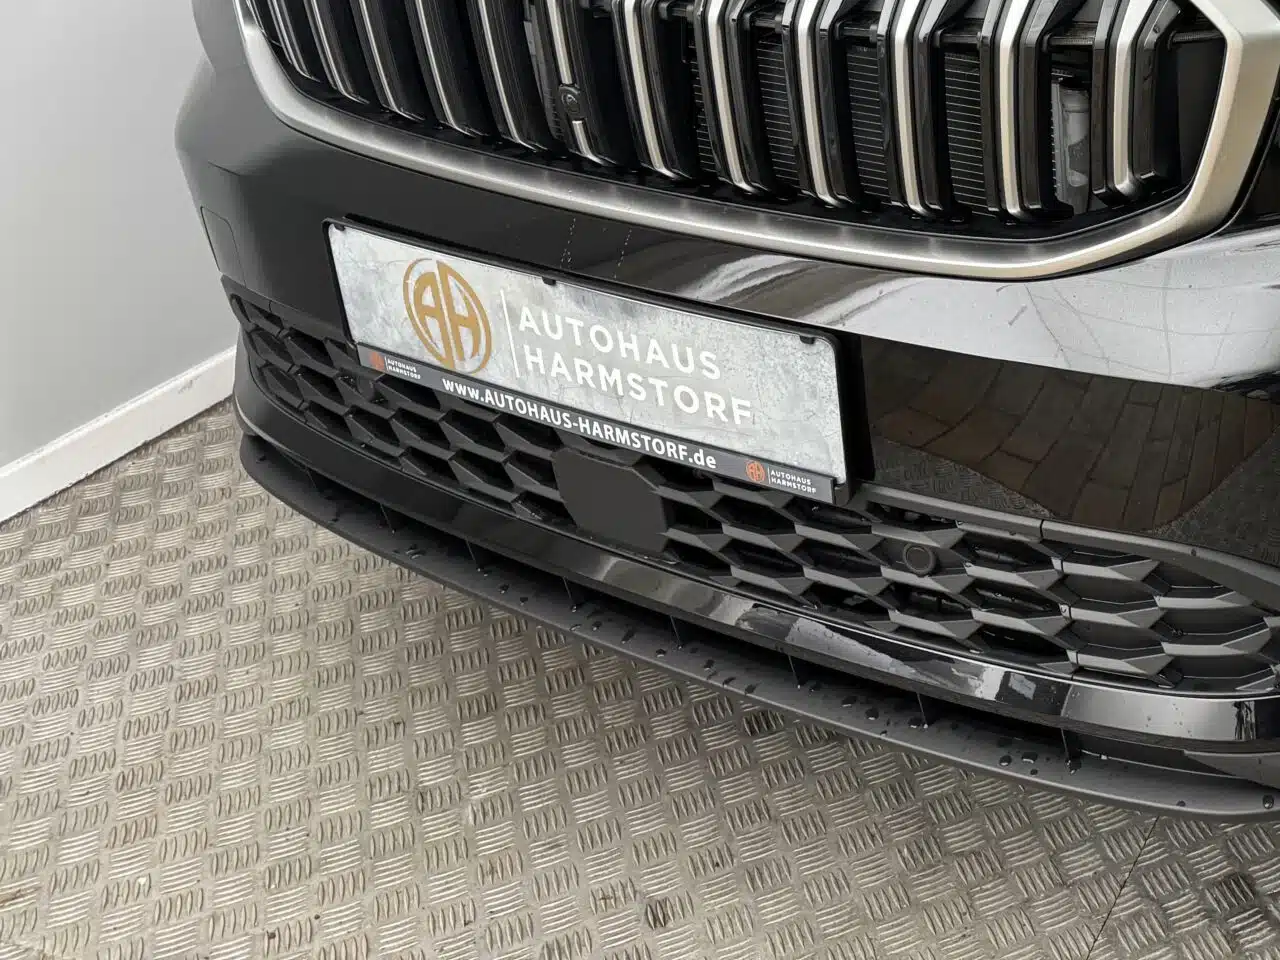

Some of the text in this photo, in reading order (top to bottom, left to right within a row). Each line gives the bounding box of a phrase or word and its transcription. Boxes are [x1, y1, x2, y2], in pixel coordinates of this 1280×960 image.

[519, 306, 721, 380] AUTOHAUS
[387, 358, 417, 373] AUTOHAUS
[388, 365, 421, 380] HARMSTORF
[525, 344, 752, 426] HARMSTORF
[441, 378, 717, 469] www.AUTOHAUS-HARMSTORF.de
[770, 469, 812, 486] AUTOHAUS
[771, 476, 817, 494] HARMSTORF
